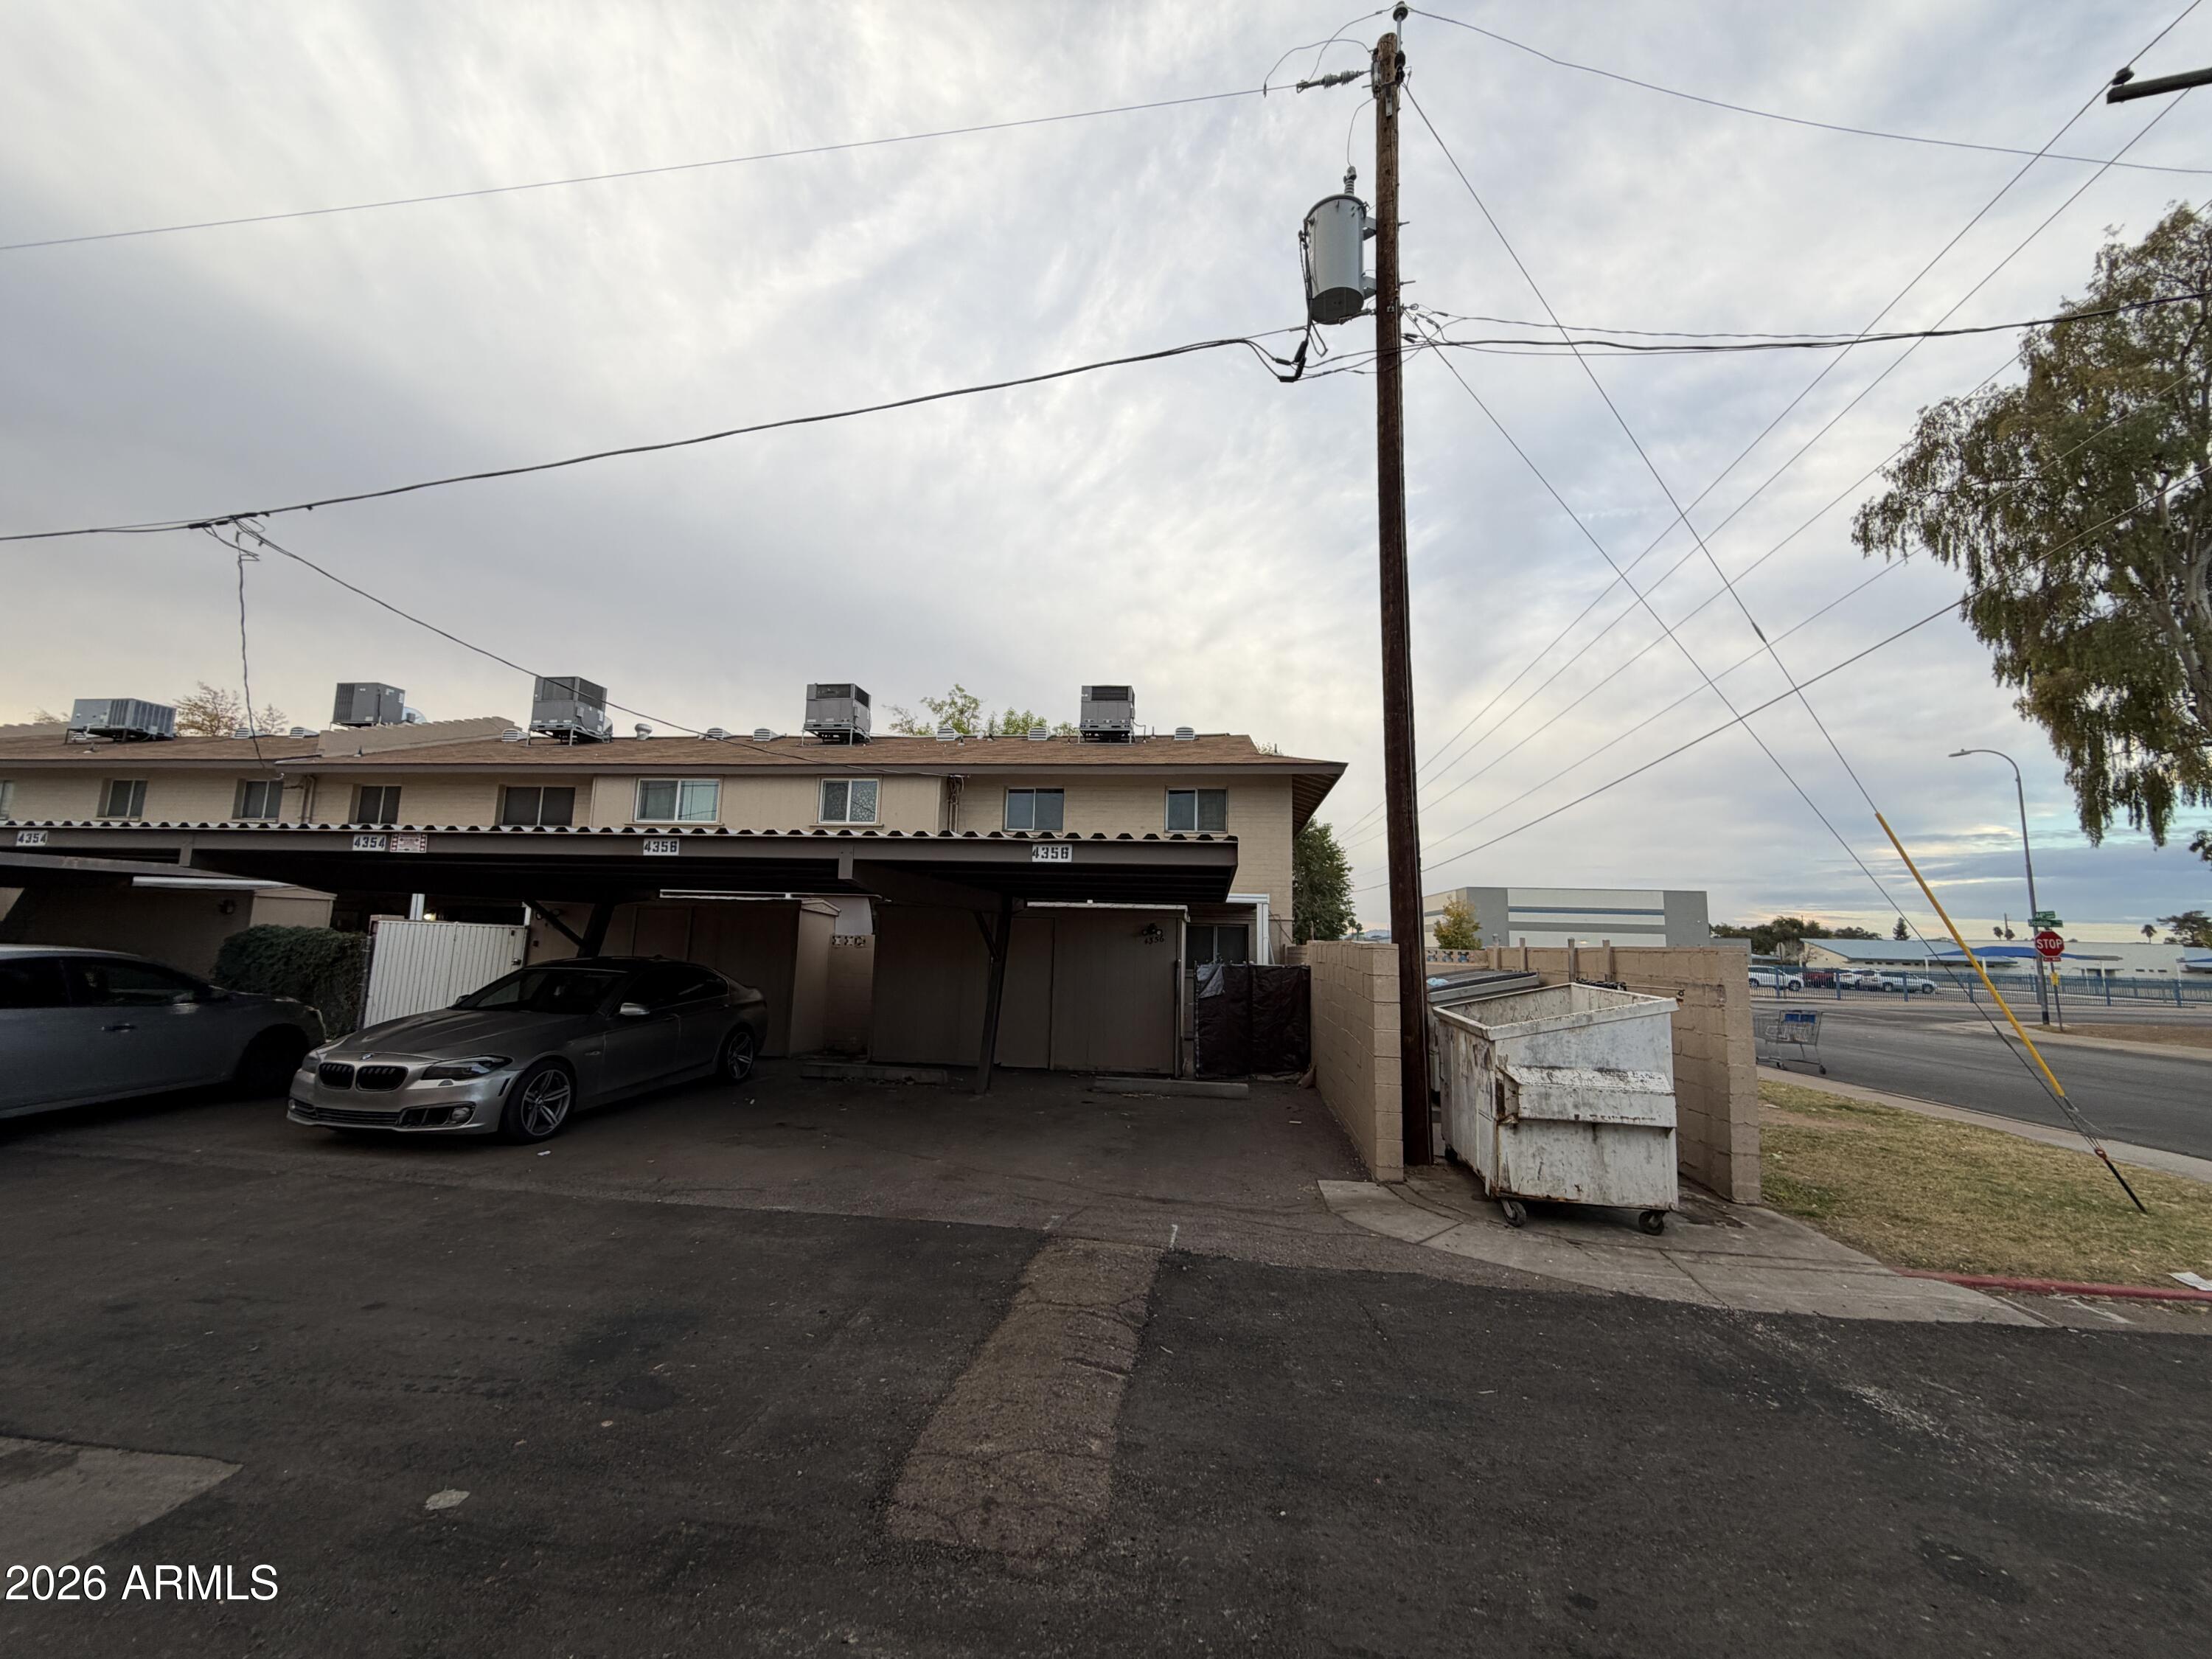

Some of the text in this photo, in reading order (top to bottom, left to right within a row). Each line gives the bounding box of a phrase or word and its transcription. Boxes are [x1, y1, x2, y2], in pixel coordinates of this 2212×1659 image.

[18, 833, 46, 844] 4354
[354, 837, 385, 848] 4354
[2037, 939, 2062, 949] STOP
